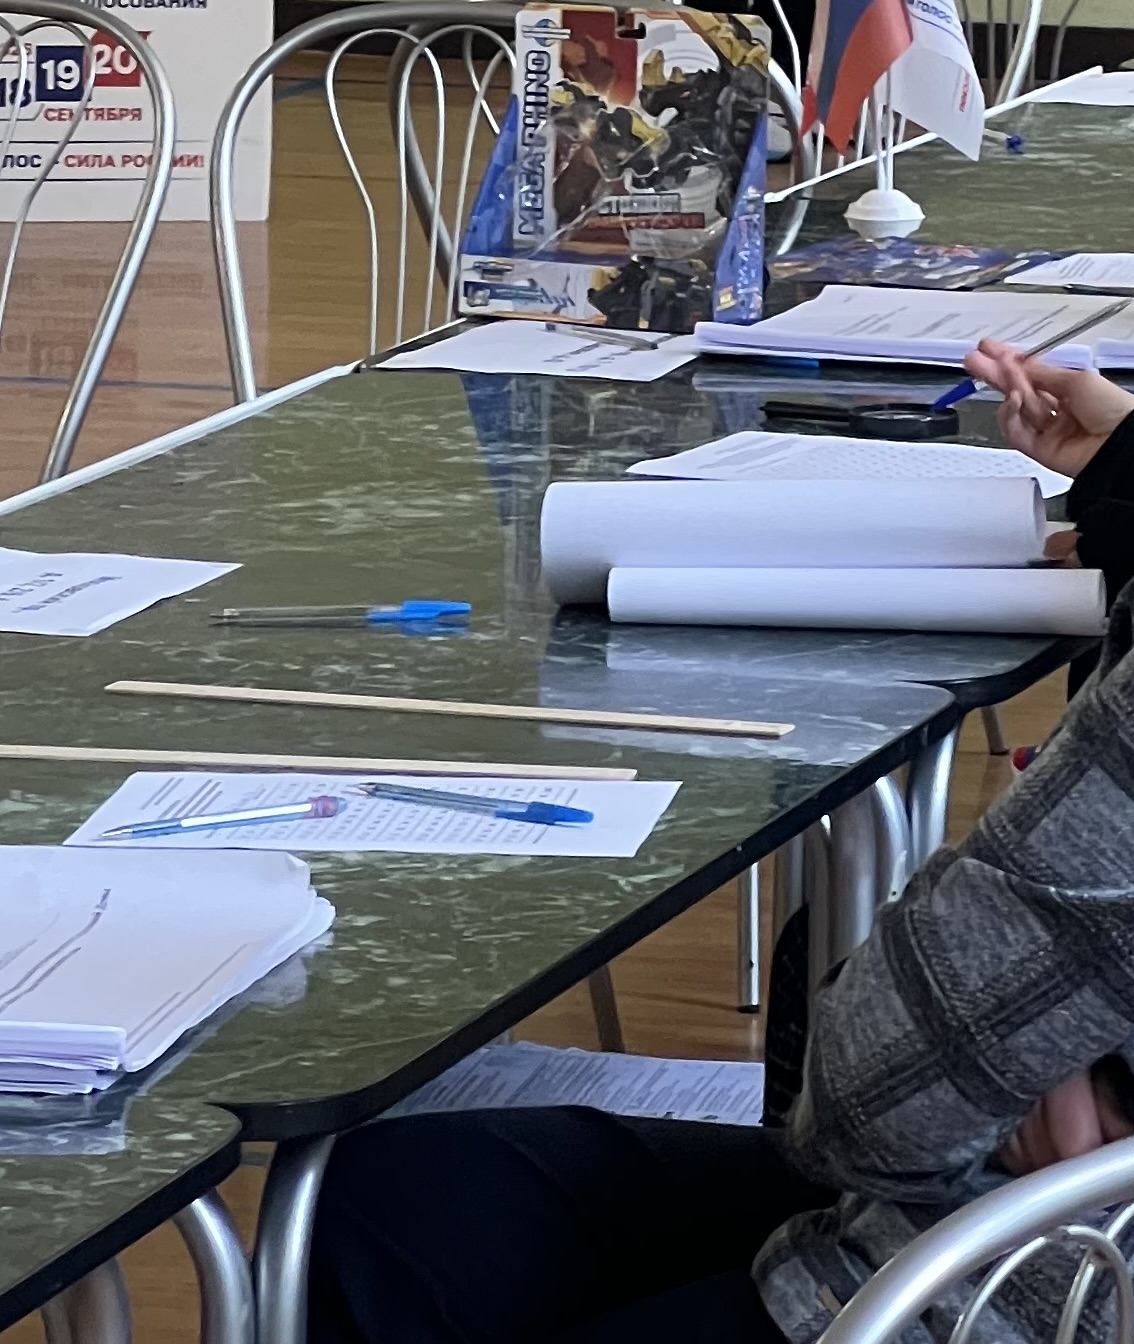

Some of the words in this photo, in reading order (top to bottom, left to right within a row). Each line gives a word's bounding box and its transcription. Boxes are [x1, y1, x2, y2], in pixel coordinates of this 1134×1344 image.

[41, 59, 80, 90] 19
[92, 44, 137, 74] 20
[64, 155, 115, 168] СИЛА
[122, 155, 204, 168] РОИИ!
